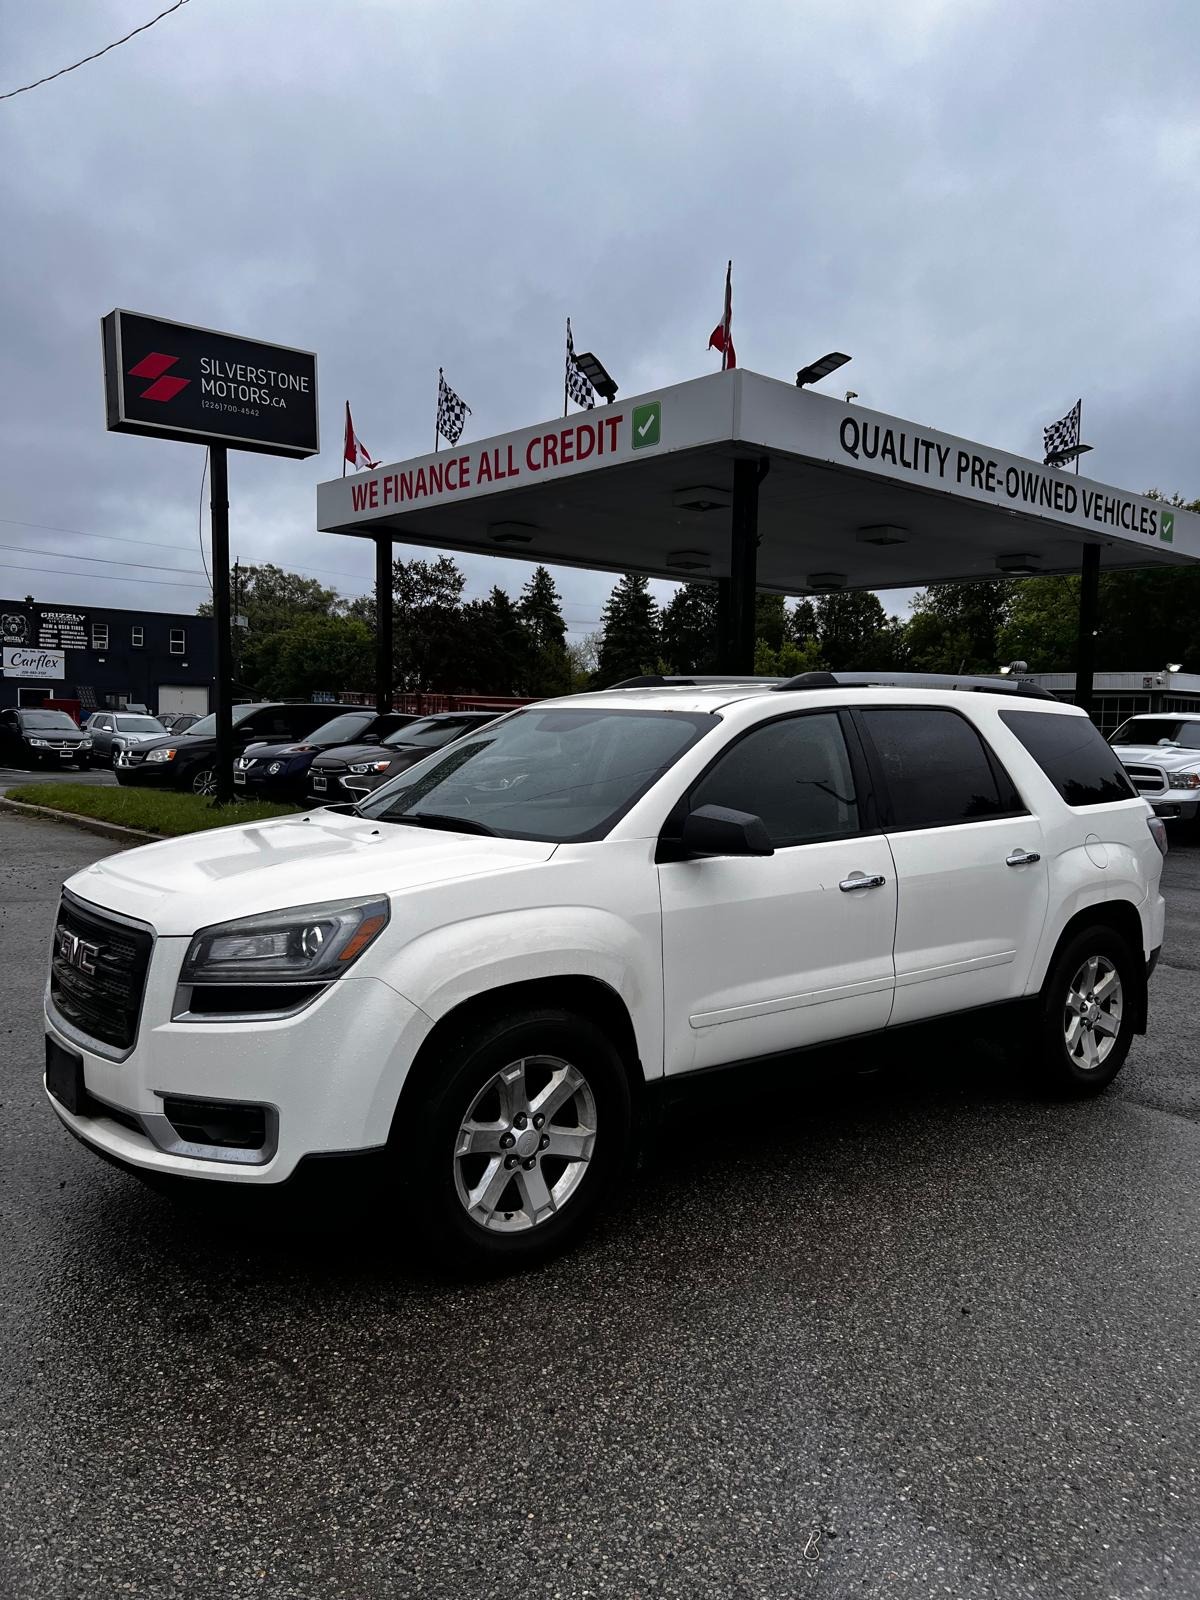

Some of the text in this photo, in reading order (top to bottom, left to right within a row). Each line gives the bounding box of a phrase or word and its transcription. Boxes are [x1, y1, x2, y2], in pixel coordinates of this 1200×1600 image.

[200, 357, 310, 393] SILVERSTONE
[201, 378, 287, 409] MOTORS.CA
[201, 400, 260, 416] (226)700-4542
[351, 415, 624, 512] WE FINANCE ALL CREDIT
[839, 416, 1158, 537] QUALITY PRE-OWNED VEHICLES
[40, 612, 86, 621] GRIZZLY
[11, 652, 59, 670] Carflex
[61, 930, 99, 976] GMC
